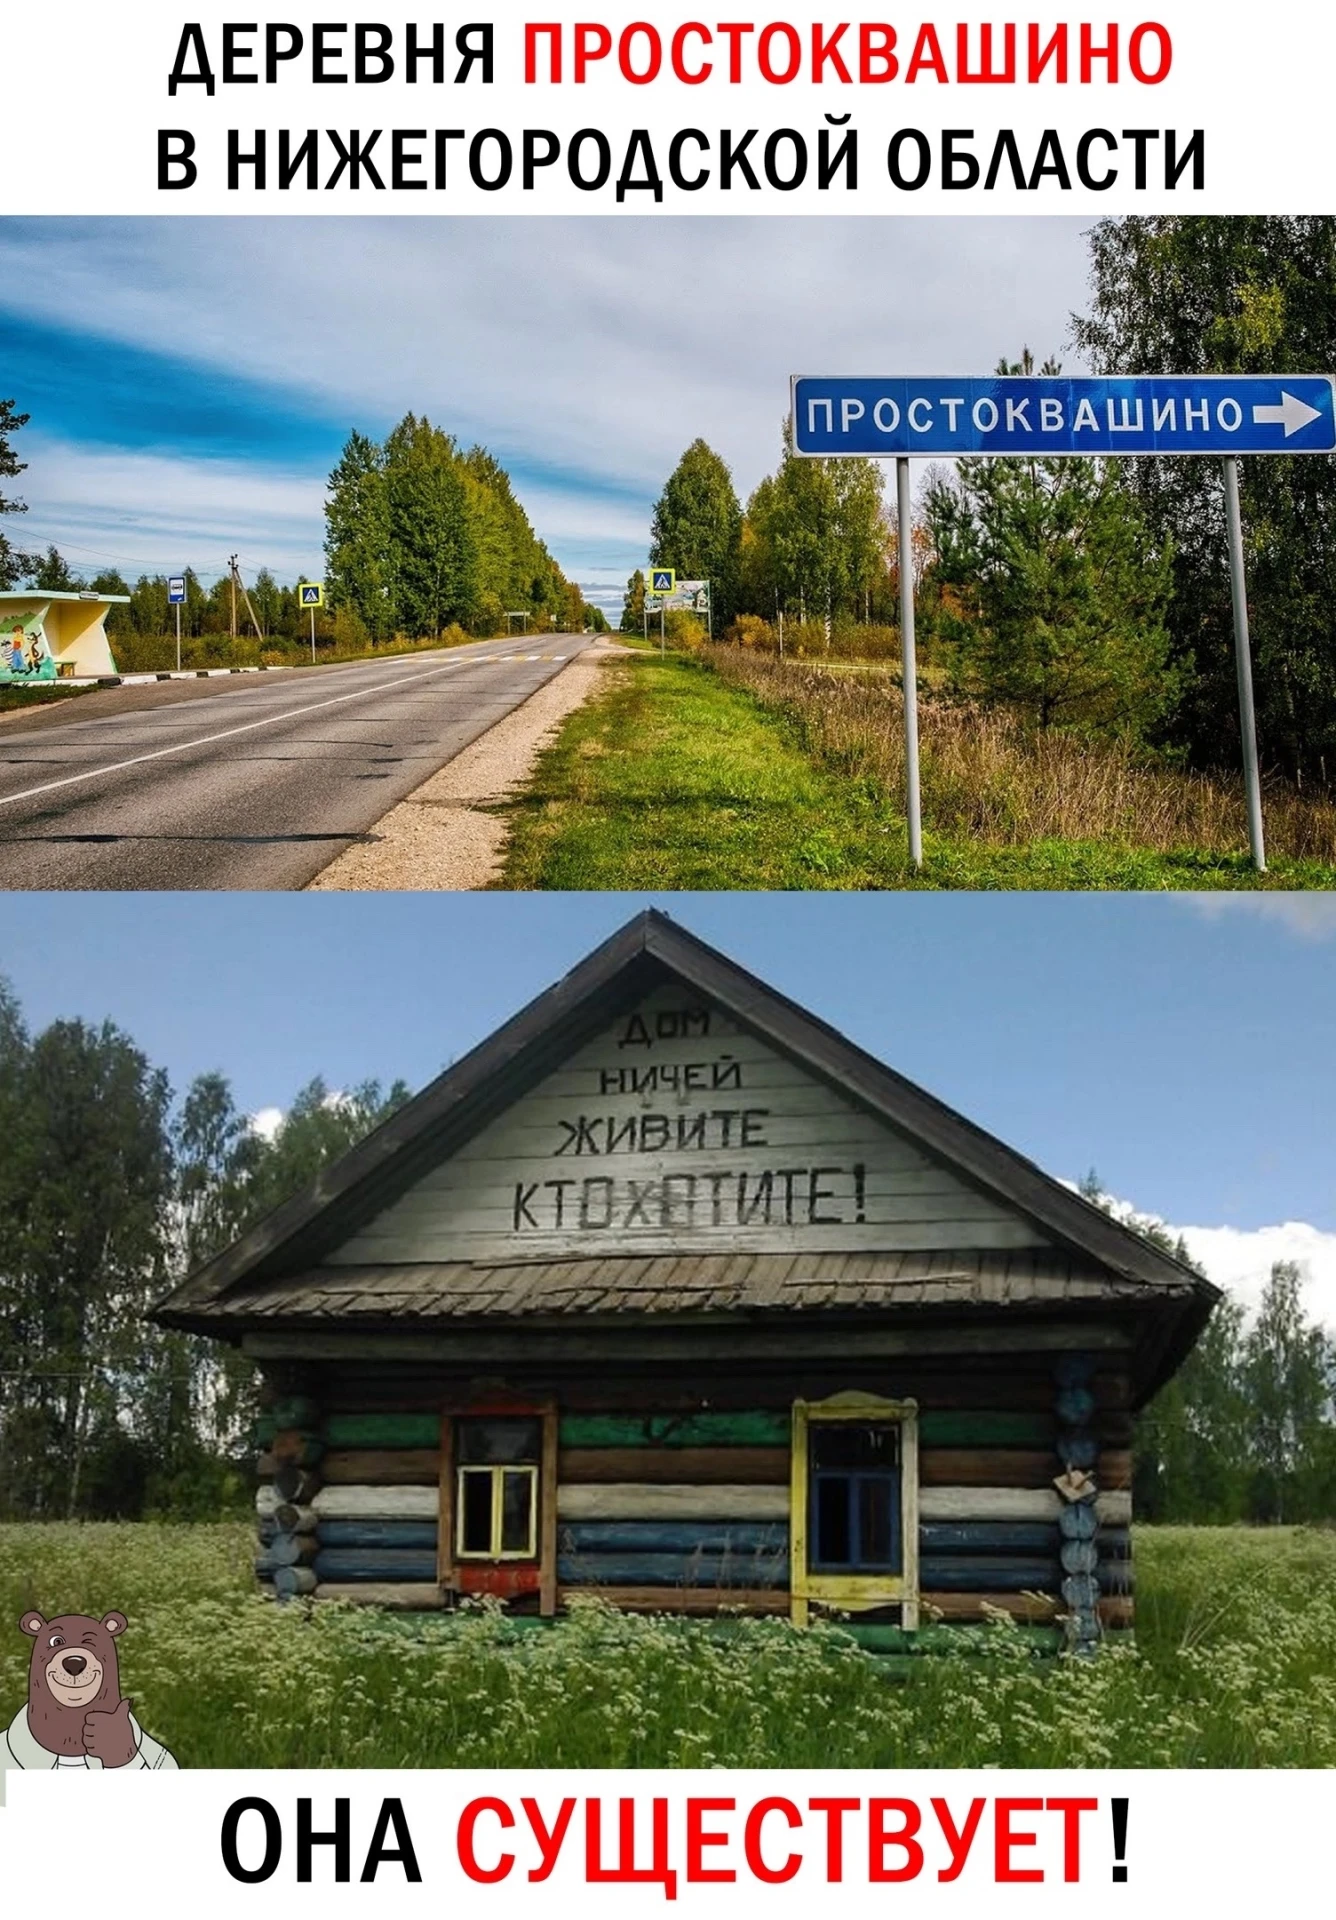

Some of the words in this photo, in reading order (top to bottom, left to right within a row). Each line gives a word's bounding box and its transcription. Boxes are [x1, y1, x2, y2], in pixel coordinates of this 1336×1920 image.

[807, 396, 1243, 434] ПРОСТОКВАШИНО
[618, 1009, 710, 1049] ДОМ
[600, 1055, 743, 1095] НИЧЕЙ
[554, 1109, 770, 1156] ЖИВИТЕ
